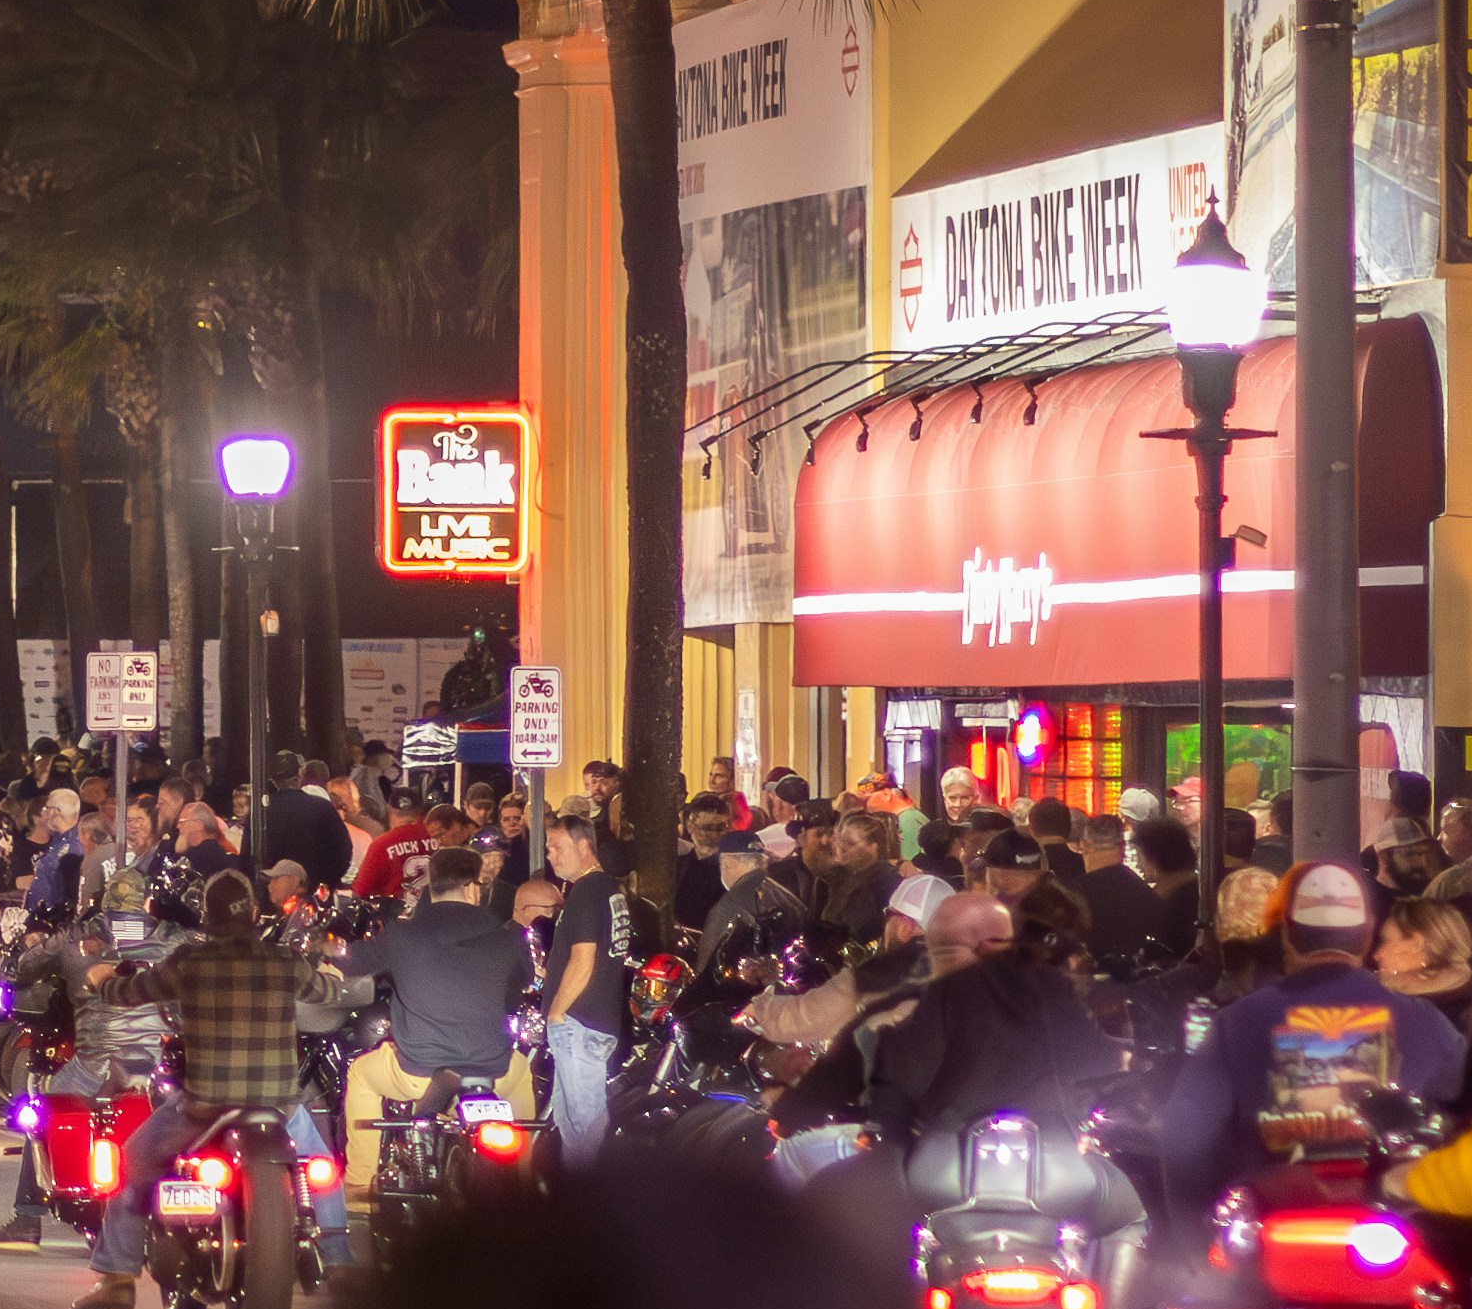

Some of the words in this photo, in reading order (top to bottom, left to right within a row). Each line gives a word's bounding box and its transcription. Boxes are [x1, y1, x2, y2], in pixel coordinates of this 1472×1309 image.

[677, 58, 718, 142] AYTONA
[722, 49, 747, 131] BIKE
[750, 38, 787, 122] WEEK
[1168, 161, 1207, 223] UNITED
[945, 200, 1025, 322] DAYTONA
[1031, 187, 1076, 307] BIKE
[1081, 174, 1143, 298] WEEK
[432, 424, 479, 460] The
[396, 448, 516, 505] Bank
[420, 513, 492, 538] LIVE
[402, 537, 512, 560] MUSIC
[98, 659, 111, 673] NO
[90, 676, 119, 689] PARKING
[123, 679, 155, 688] PARKING
[129, 692, 146, 701] ONLY
[96, 704, 113, 712] TIME
[513, 702, 559, 714] PARKING
[523, 718, 550, 731] ONLY
[514, 733, 559, 745] 10AM-2AM
[387, 840, 419, 860] FUCK
[422, 837, 442, 853] YO
